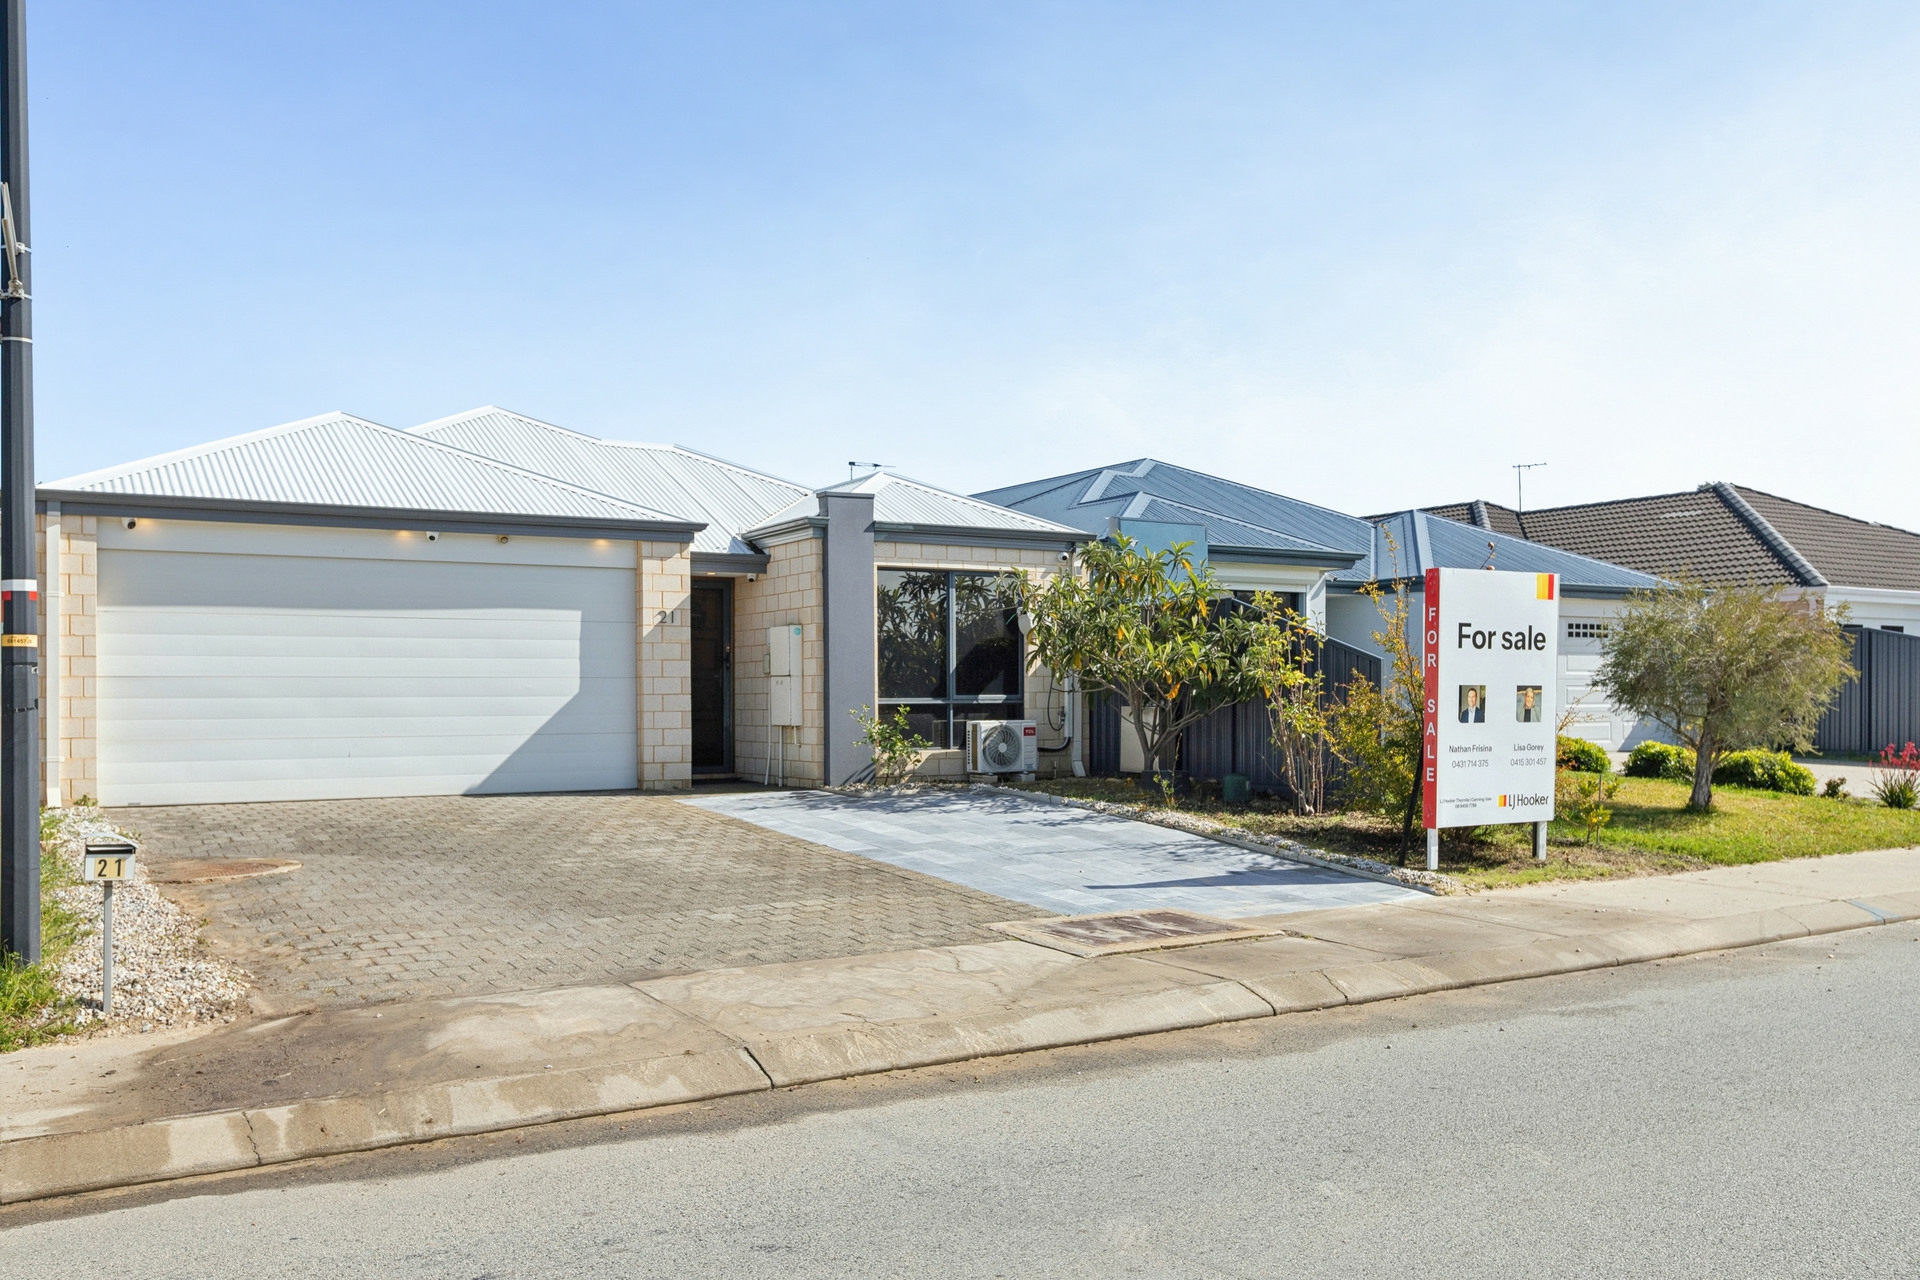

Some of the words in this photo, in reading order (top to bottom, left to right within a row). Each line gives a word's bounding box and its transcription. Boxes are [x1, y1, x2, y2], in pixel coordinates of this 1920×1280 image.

[657, 610, 674, 624] 21
[1427, 606, 1437, 668] FOR
[1457, 622, 1497, 650] For
[1501, 625, 1547, 651] sale
[1426, 697, 1437, 782] SALE
[1449, 744, 1471, 753] Nathan
[1472, 744, 1492, 752] Frisina
[1514, 743, 1526, 752] Lisa
[1526, 743, 1544, 753] Gorey
[1452, 760, 1467, 769] 0431
[1467, 760, 1477, 768] 714
[1478, 759, 1489, 767] 375
[1510, 758, 1525, 767] 0415
[1525, 758, 1536, 766] 301
[1509, 794, 1516, 810] LJ
[1517, 793, 1549, 806] Hooker
[97, 858, 122, 877] 21
